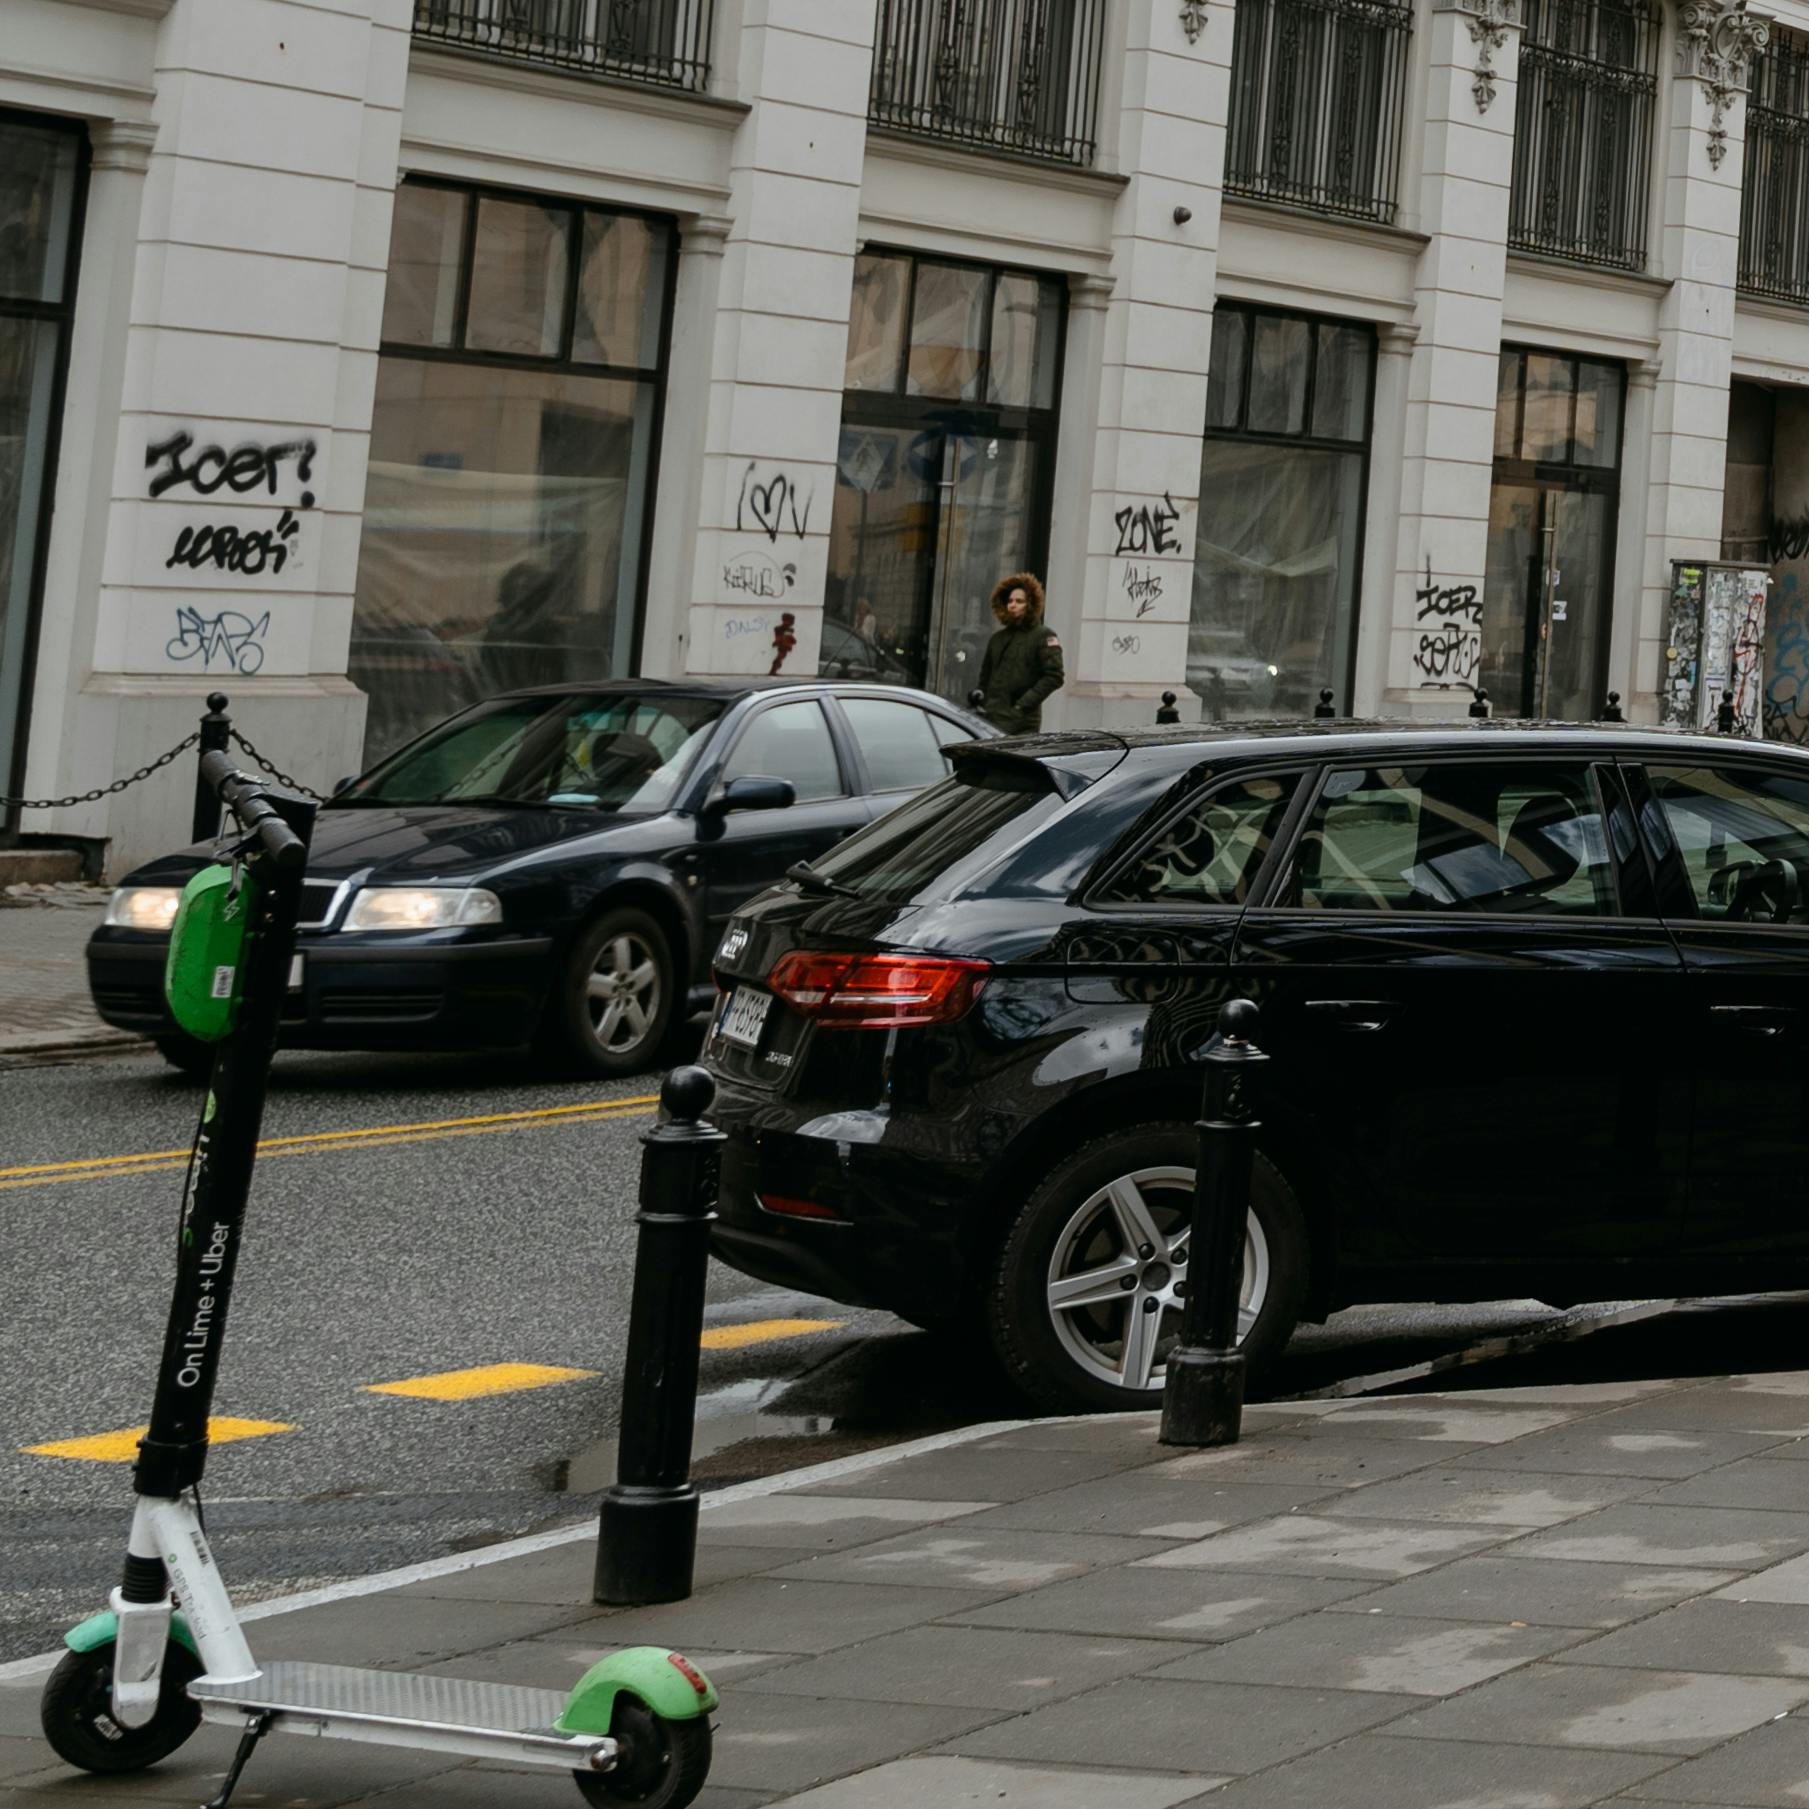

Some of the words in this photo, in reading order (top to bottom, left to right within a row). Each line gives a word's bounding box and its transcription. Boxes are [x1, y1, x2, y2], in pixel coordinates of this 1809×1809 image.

[199, 1221, 230, 1275] Uber
[183, 1294, 215, 1349] Lime
[178, 1353, 204, 1388] On
